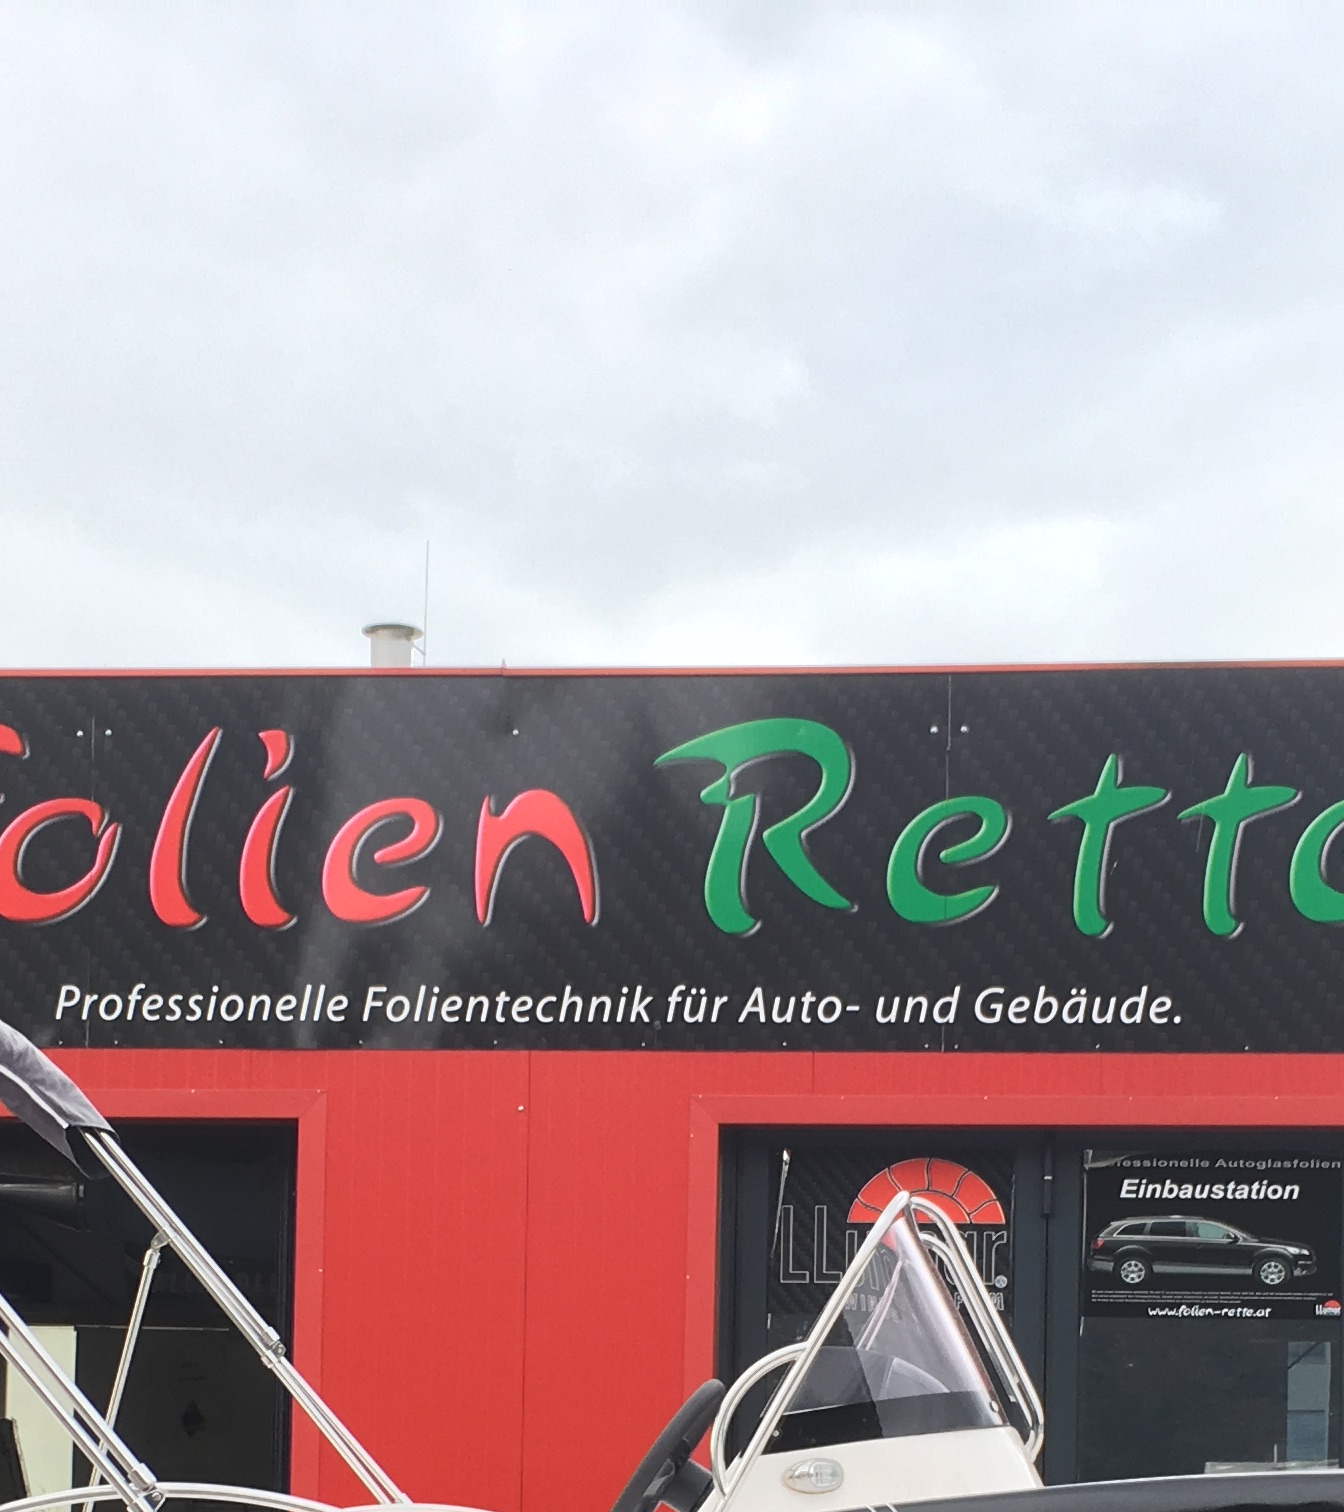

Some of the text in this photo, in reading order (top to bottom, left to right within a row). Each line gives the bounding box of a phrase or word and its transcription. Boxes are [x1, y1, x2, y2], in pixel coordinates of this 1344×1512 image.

[54, 984, 1183, 1024] Professionelle Folientechnik für Auto- und Gebäude.
[1214, 1158, 1341, 1170] Autoglasfolien
[1119, 1178, 1300, 1201] Einbaustation
[1148, 1304, 1271, 1318] www.folien-rette.at
